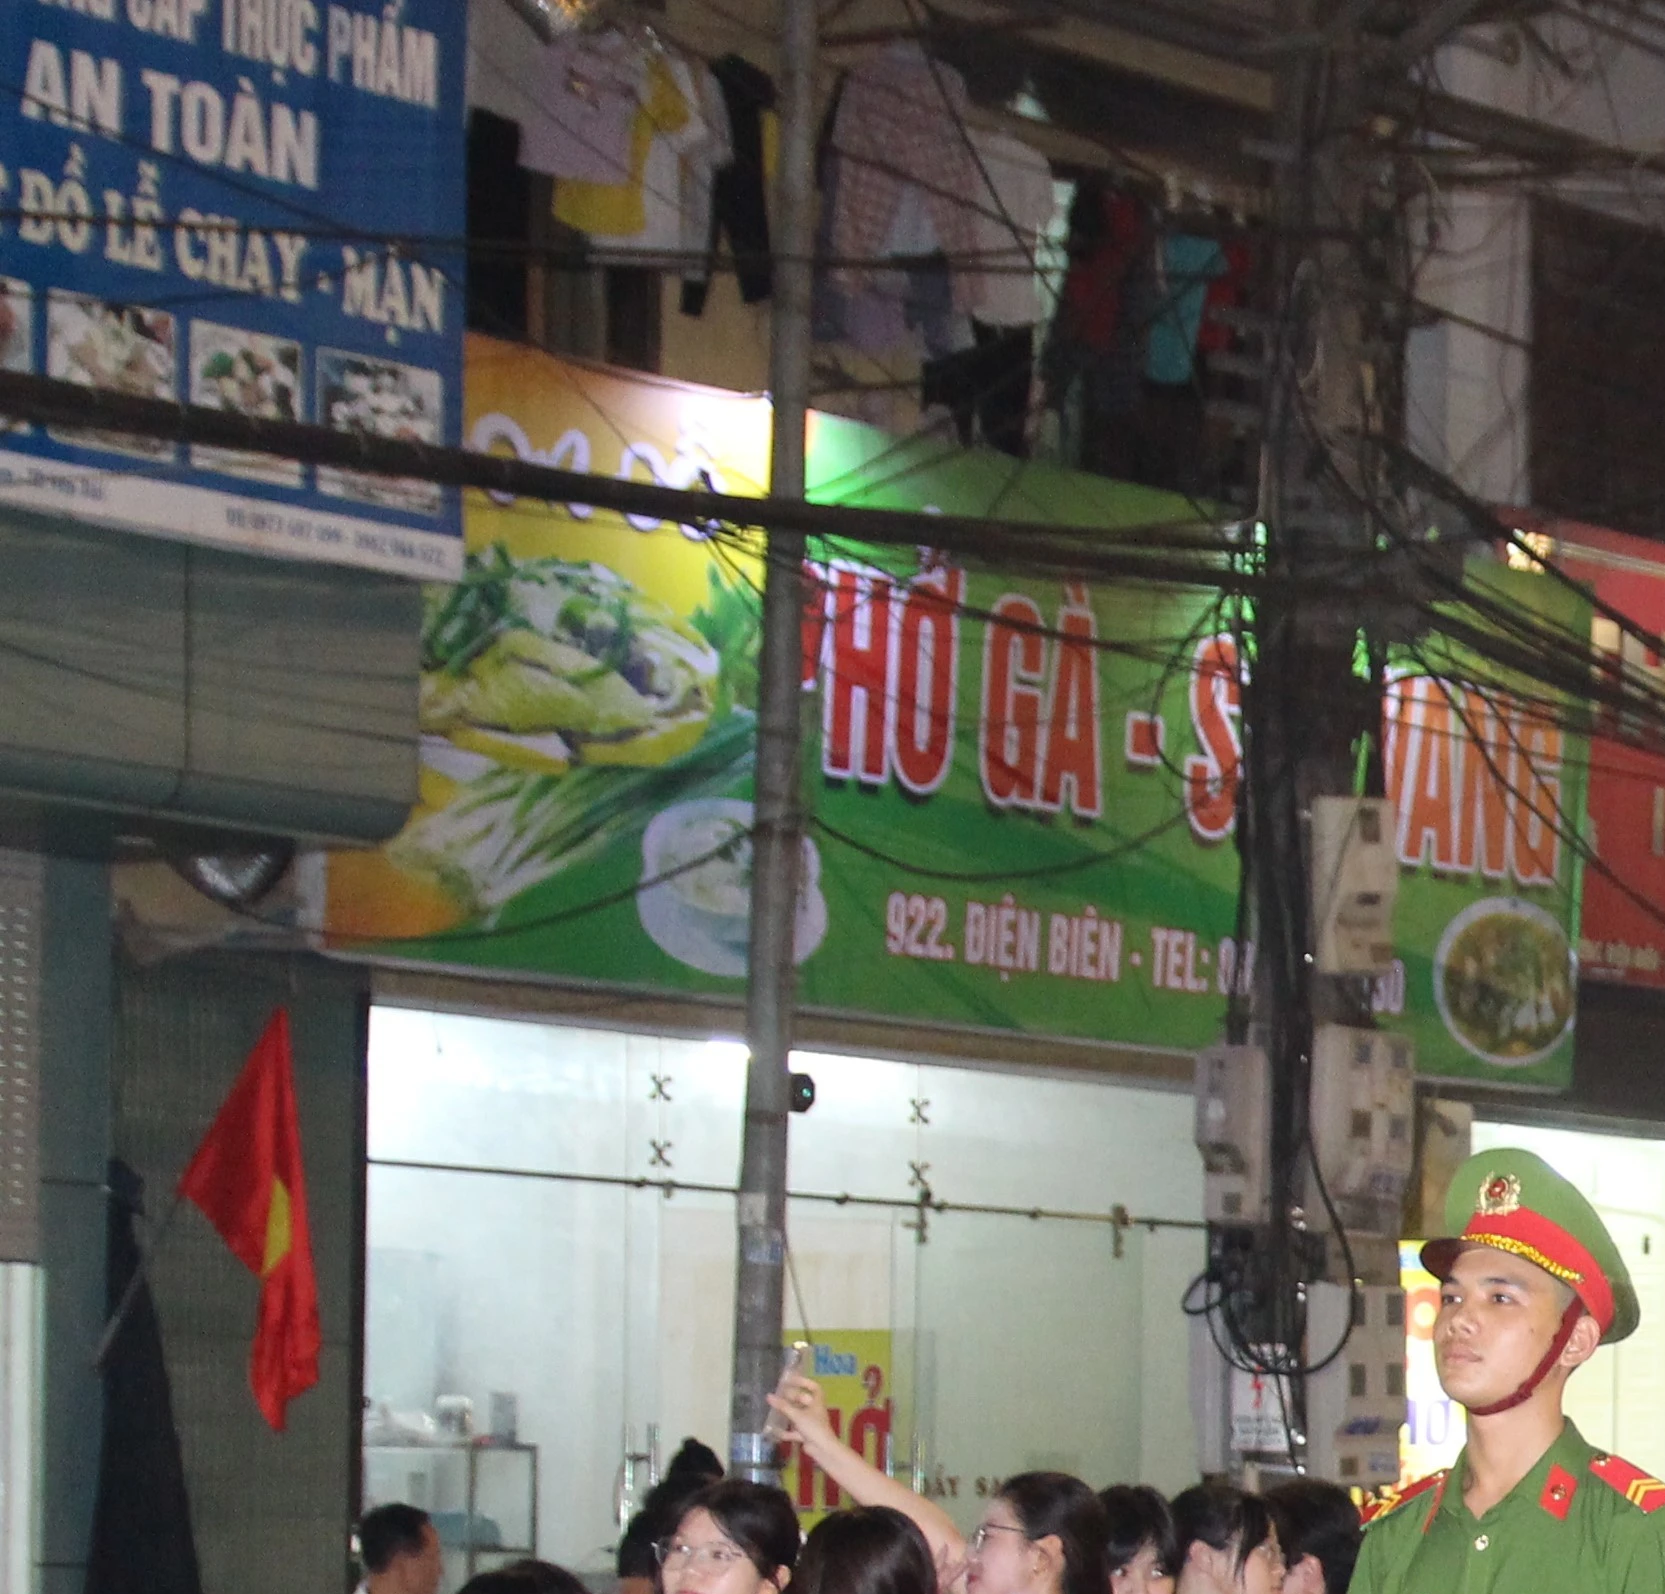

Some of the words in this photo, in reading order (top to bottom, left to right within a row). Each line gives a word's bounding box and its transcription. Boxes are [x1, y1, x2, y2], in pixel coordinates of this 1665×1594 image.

[21, 39, 122, 136] AN
[141, 69, 319, 190] TOÀN
[175, 207, 308, 302] CHAY
